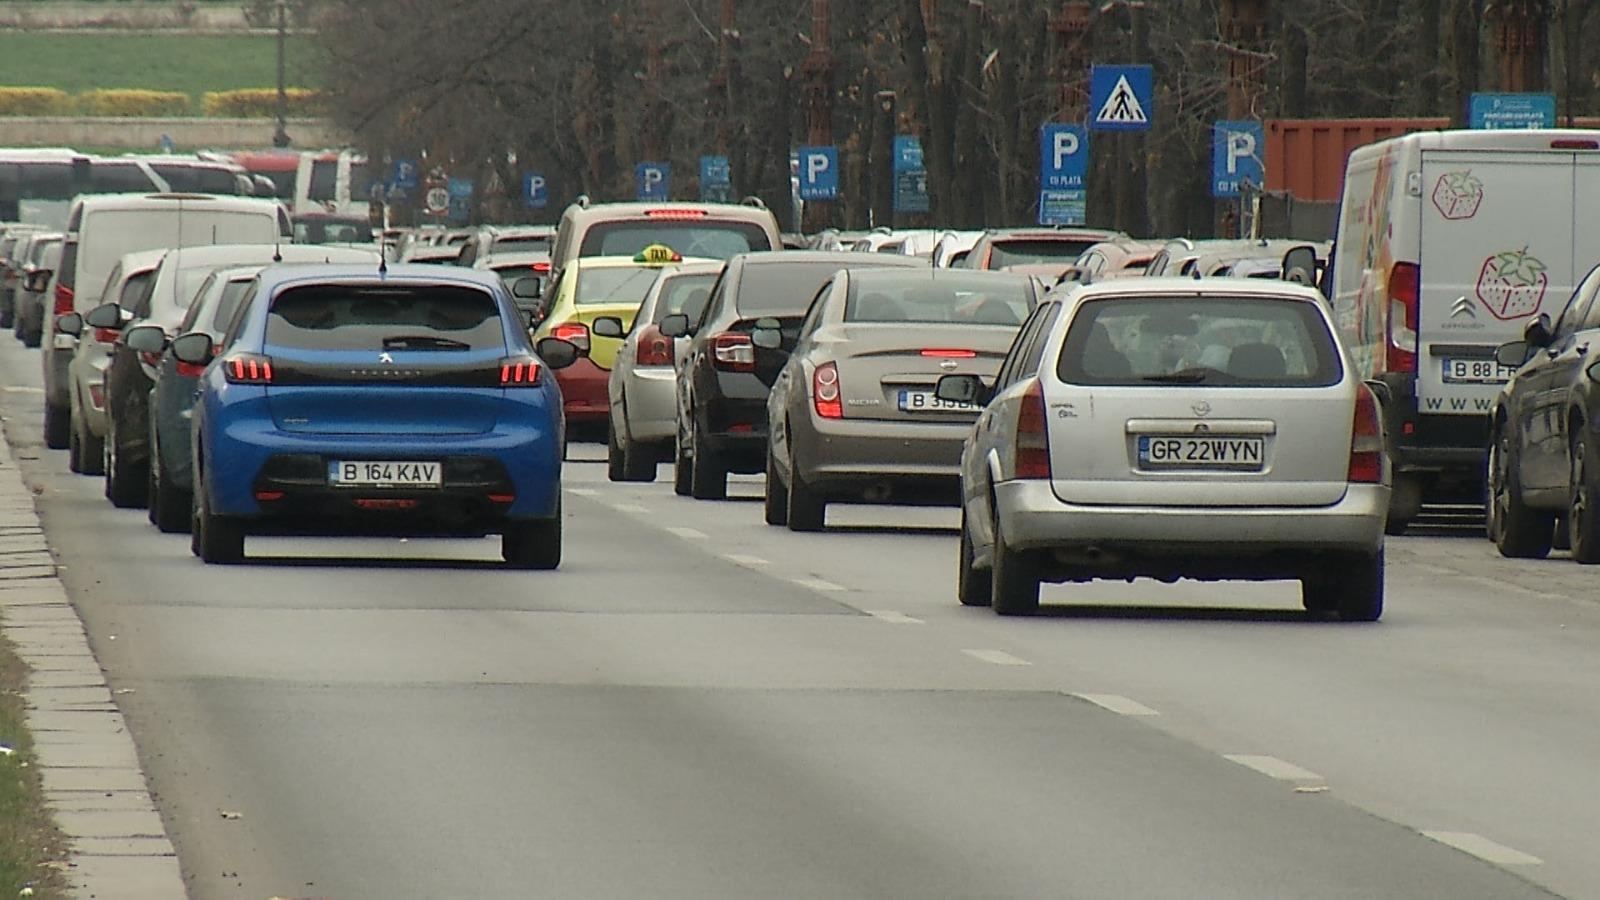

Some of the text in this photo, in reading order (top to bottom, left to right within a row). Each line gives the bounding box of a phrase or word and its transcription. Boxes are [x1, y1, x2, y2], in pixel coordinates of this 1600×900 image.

[1053, 132, 1079, 169] P
[1227, 130, 1256, 173] P
[808, 154, 829, 183] P
[531, 176, 545, 196] P
[645, 168, 662, 192] P
[650, 249, 667, 260] TAXI
[1456, 363, 1466, 376] B
[1473, 363, 1491, 377] 88
[913, 394, 925, 407] B
[1152, 441, 1181, 460] GR
[344, 464, 435, 482] B 164 KAV
